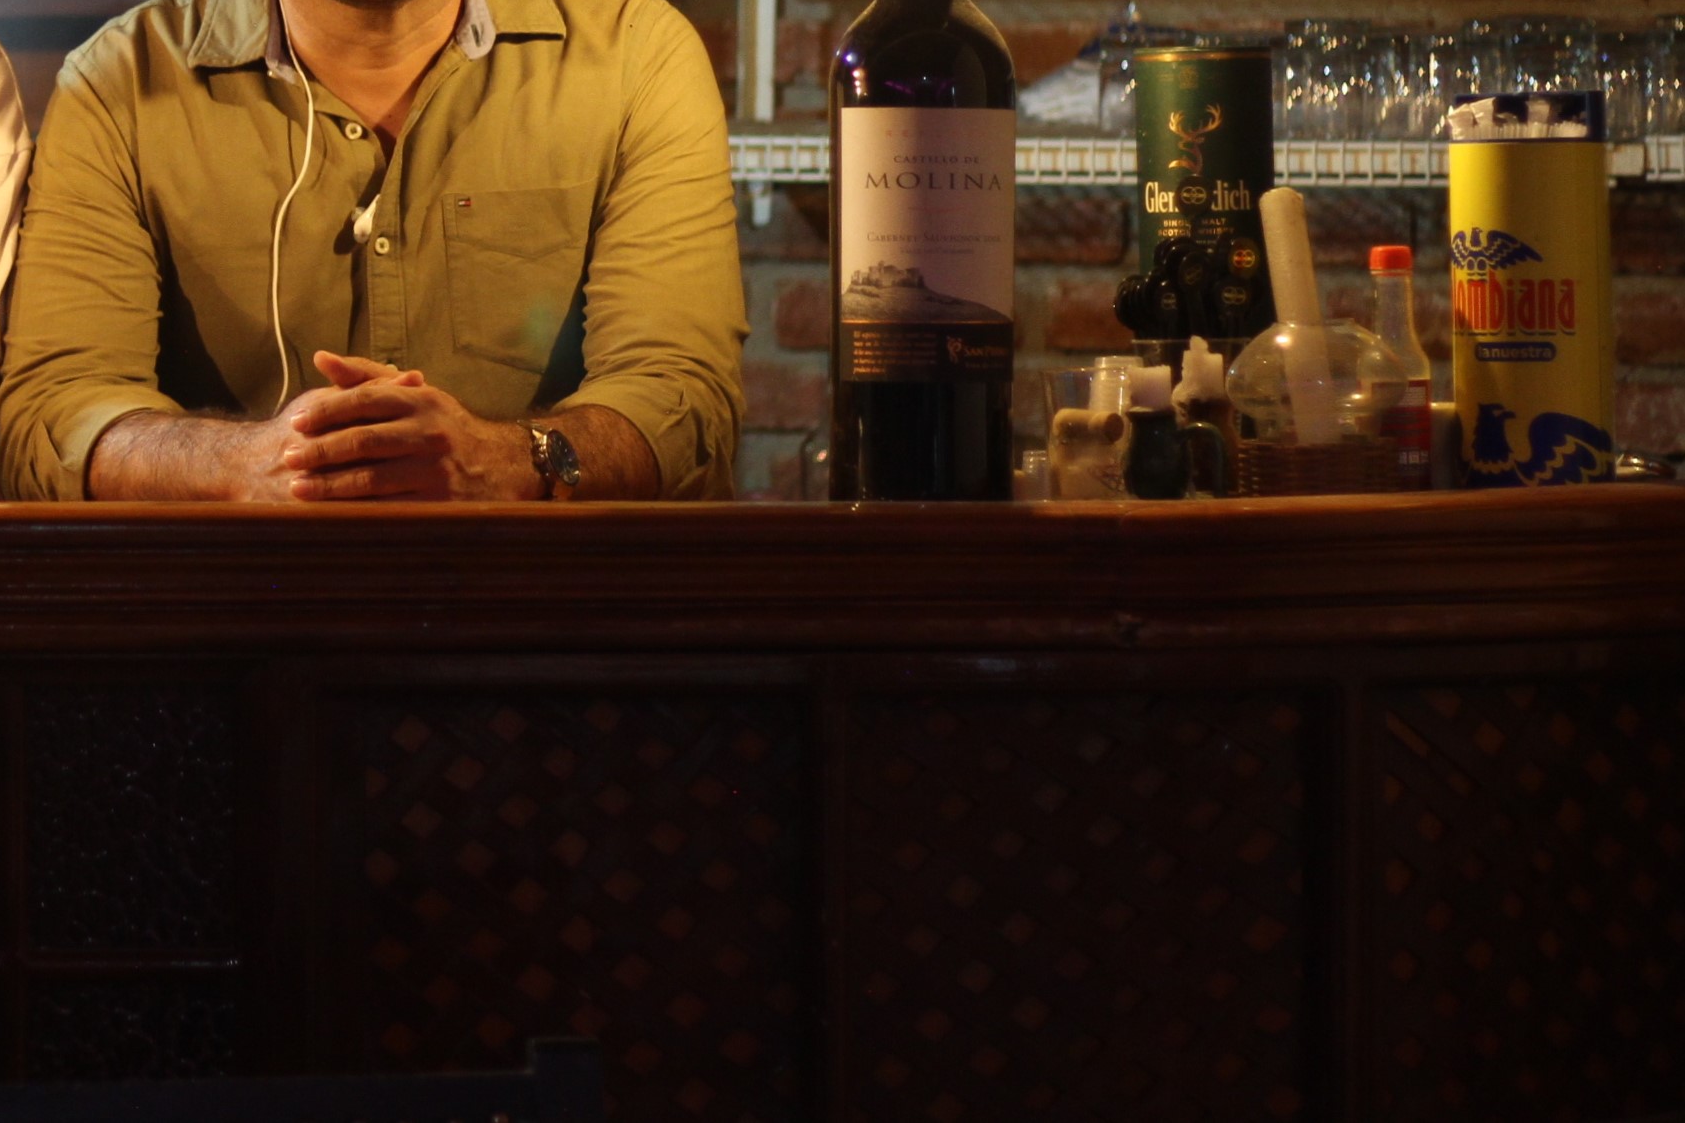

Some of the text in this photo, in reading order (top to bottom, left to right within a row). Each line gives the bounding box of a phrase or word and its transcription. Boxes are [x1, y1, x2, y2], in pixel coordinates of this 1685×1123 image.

[893, 154, 980, 164] CASTILLO DE
[864, 171, 1002, 191] MOLINA
[1144, 179, 1252, 214] Glendich
